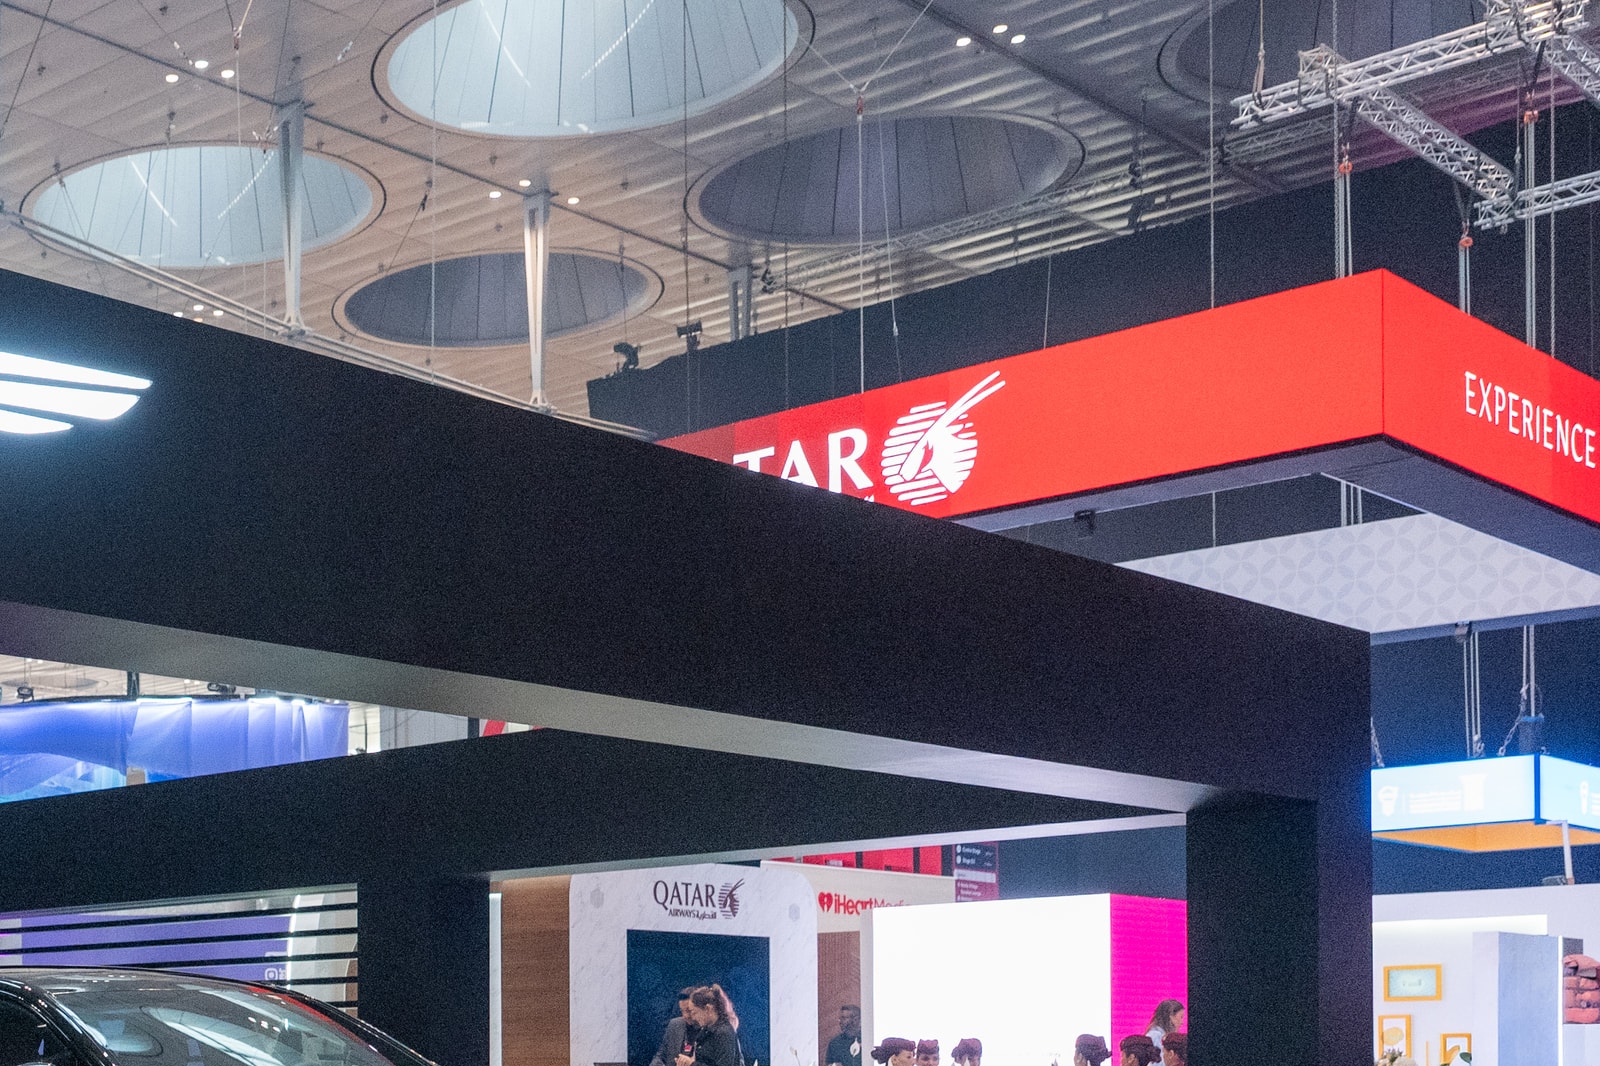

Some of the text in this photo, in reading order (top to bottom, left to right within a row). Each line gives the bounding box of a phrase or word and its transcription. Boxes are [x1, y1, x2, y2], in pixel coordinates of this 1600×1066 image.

[1464, 371, 1596, 469] EXPERIENCE
[732, 428, 874, 494] TAR
[653, 880, 716, 911] QATAR
[668, 908, 695, 918] AIRWAYS
